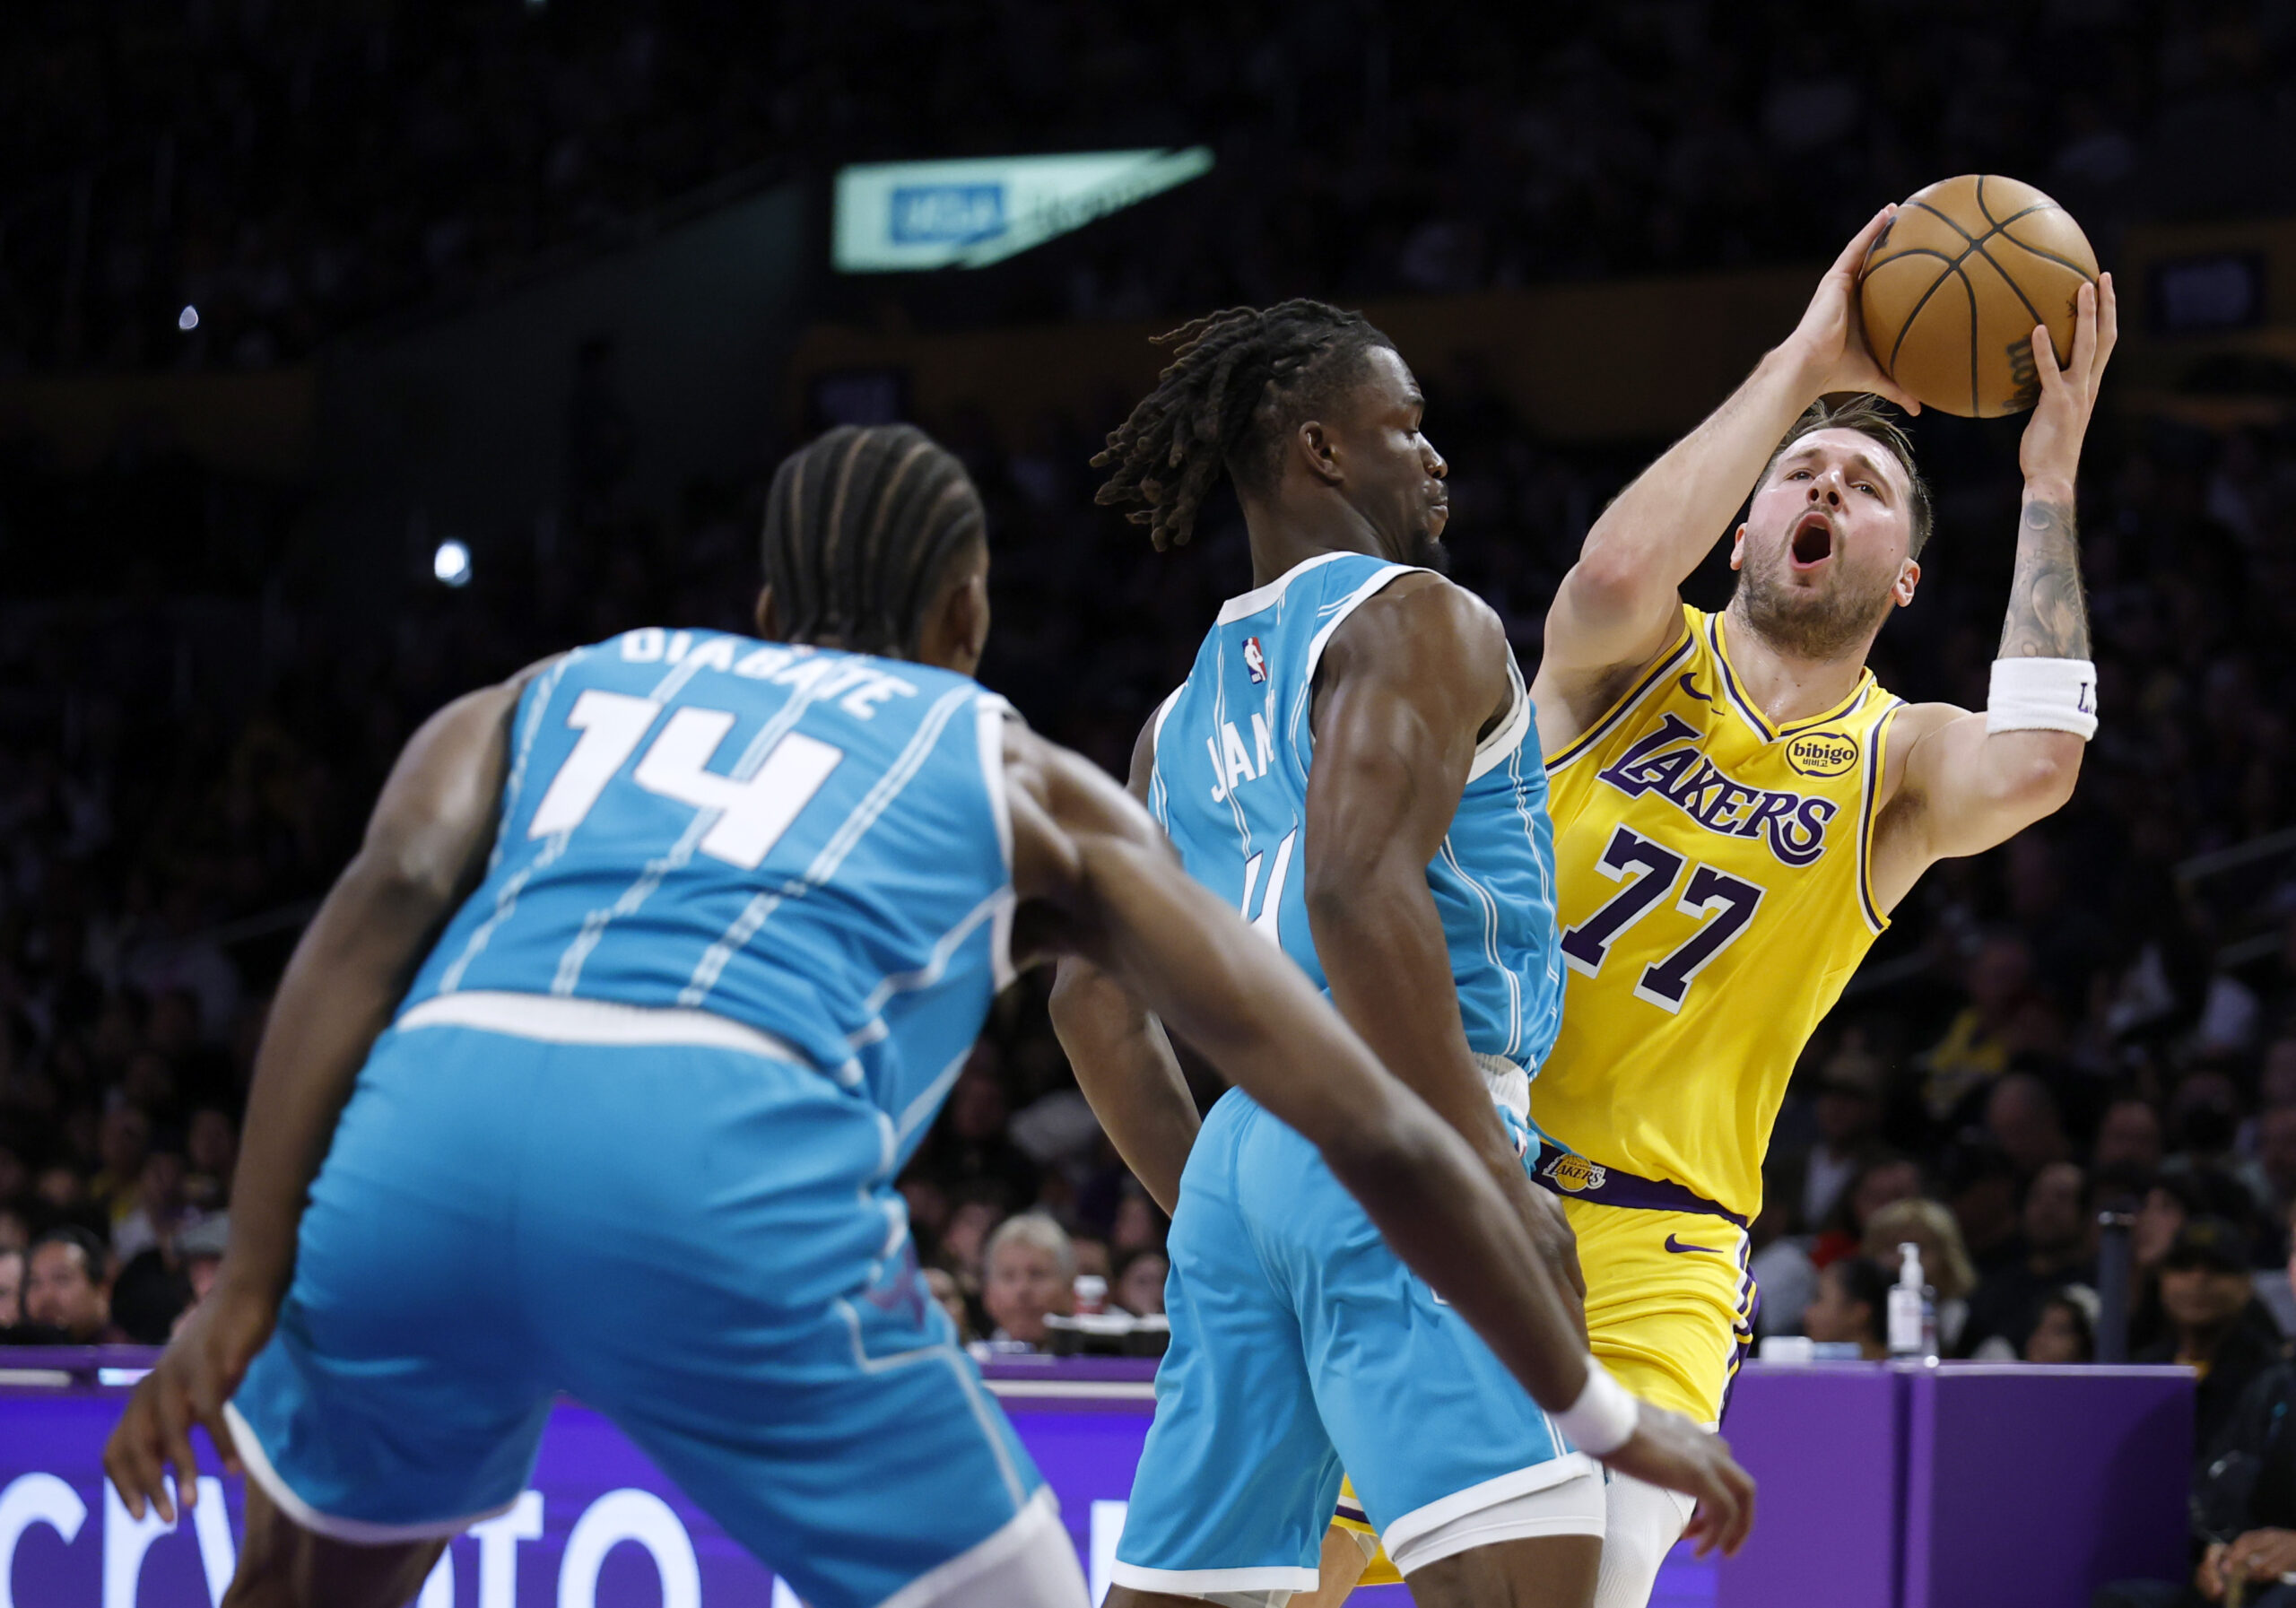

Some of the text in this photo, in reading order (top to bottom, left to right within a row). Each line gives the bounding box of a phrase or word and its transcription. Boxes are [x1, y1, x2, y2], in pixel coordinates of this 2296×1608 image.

[620, 627, 918, 721] DIABATE
[527, 688, 844, 871] 14
[1595, 710, 1841, 868] LAKERS
[1794, 743, 1855, 765] bibigo
[1561, 821, 1768, 1015] 77
[1544, 1158, 1605, 1188] LAKERS
